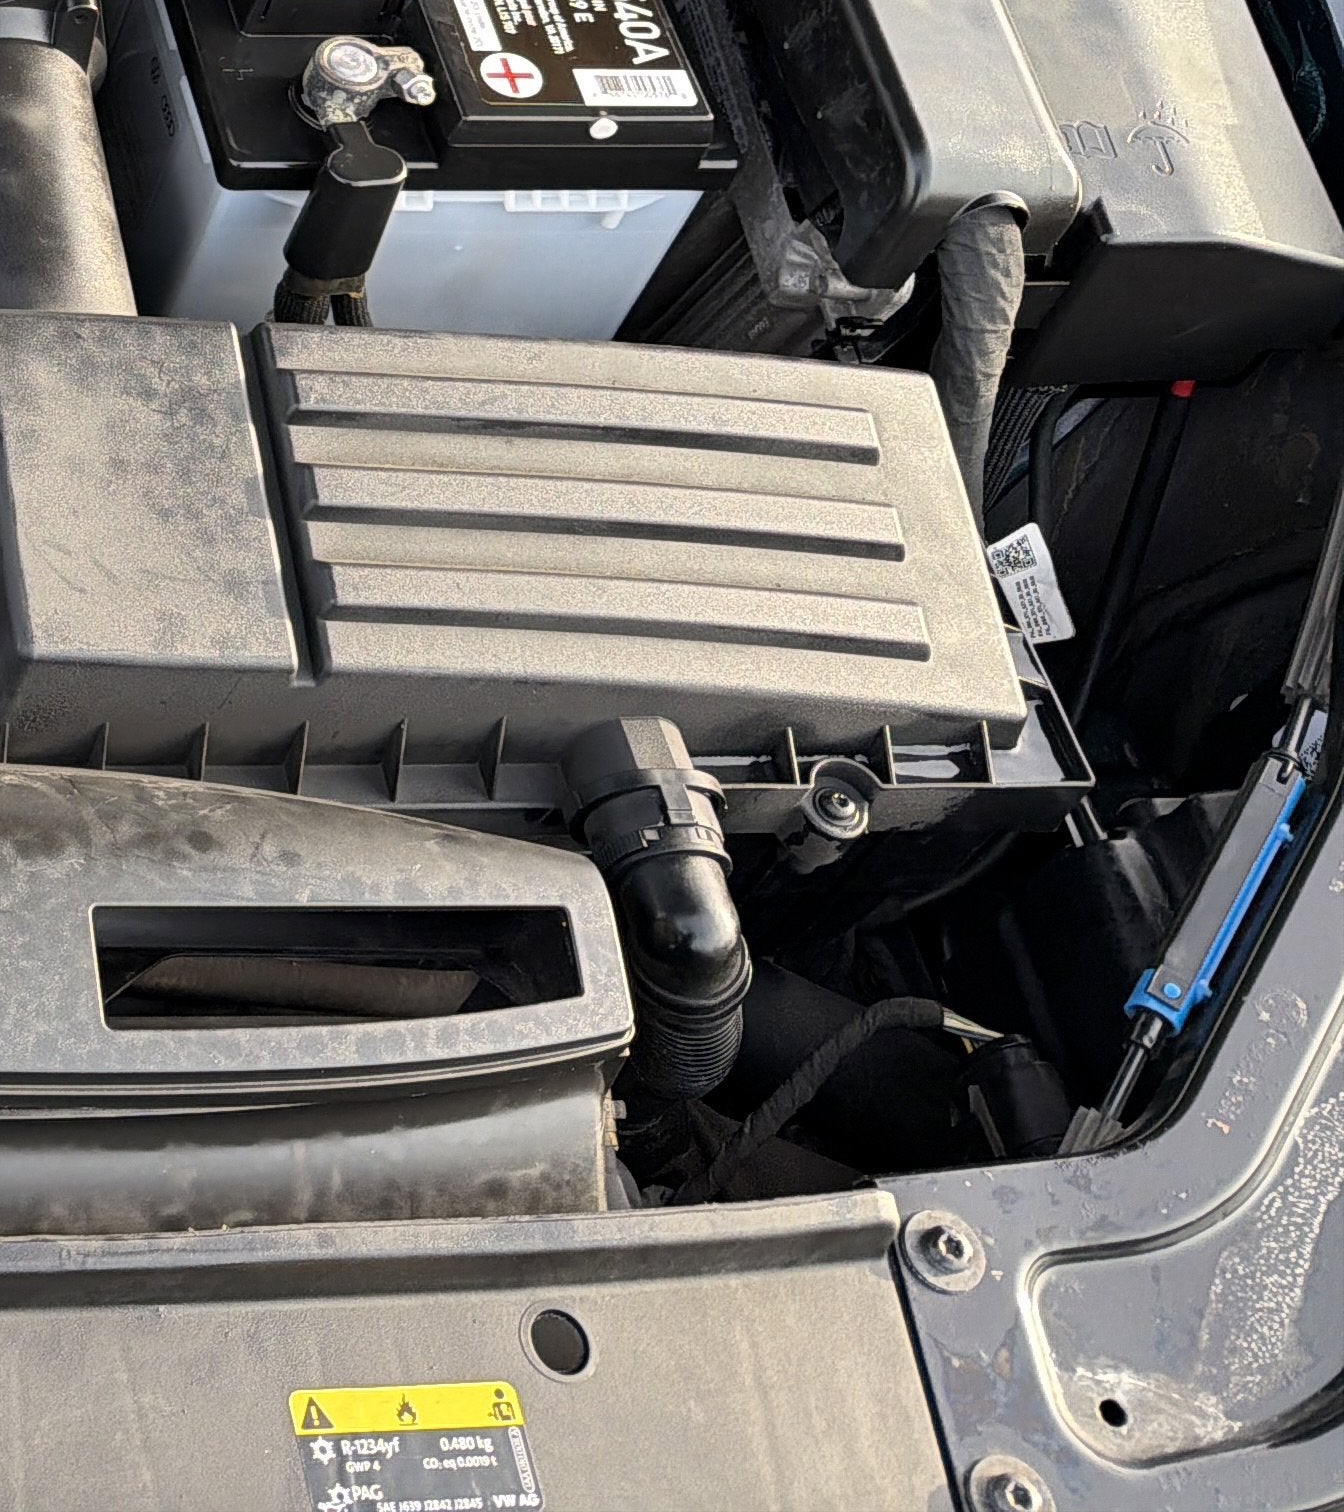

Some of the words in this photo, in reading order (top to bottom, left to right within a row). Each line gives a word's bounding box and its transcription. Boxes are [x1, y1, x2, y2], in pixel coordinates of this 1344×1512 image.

[571, 13, 594, 22] E
[341, 1438, 400, 1458] R-1234yf
[440, 1438, 474, 1451] 0.480
[477, 1438, 493, 1453] kg
[346, 1461, 370, 1473] GWP
[373, 1460, 381, 1471] 4
[443, 1459, 456, 1470] eq
[491, 1457, 497, 1466] t
[353, 1486, 384, 1500] PAG
[493, 1494, 516, 1508] VW
[519, 1493, 539, 1505] AG
